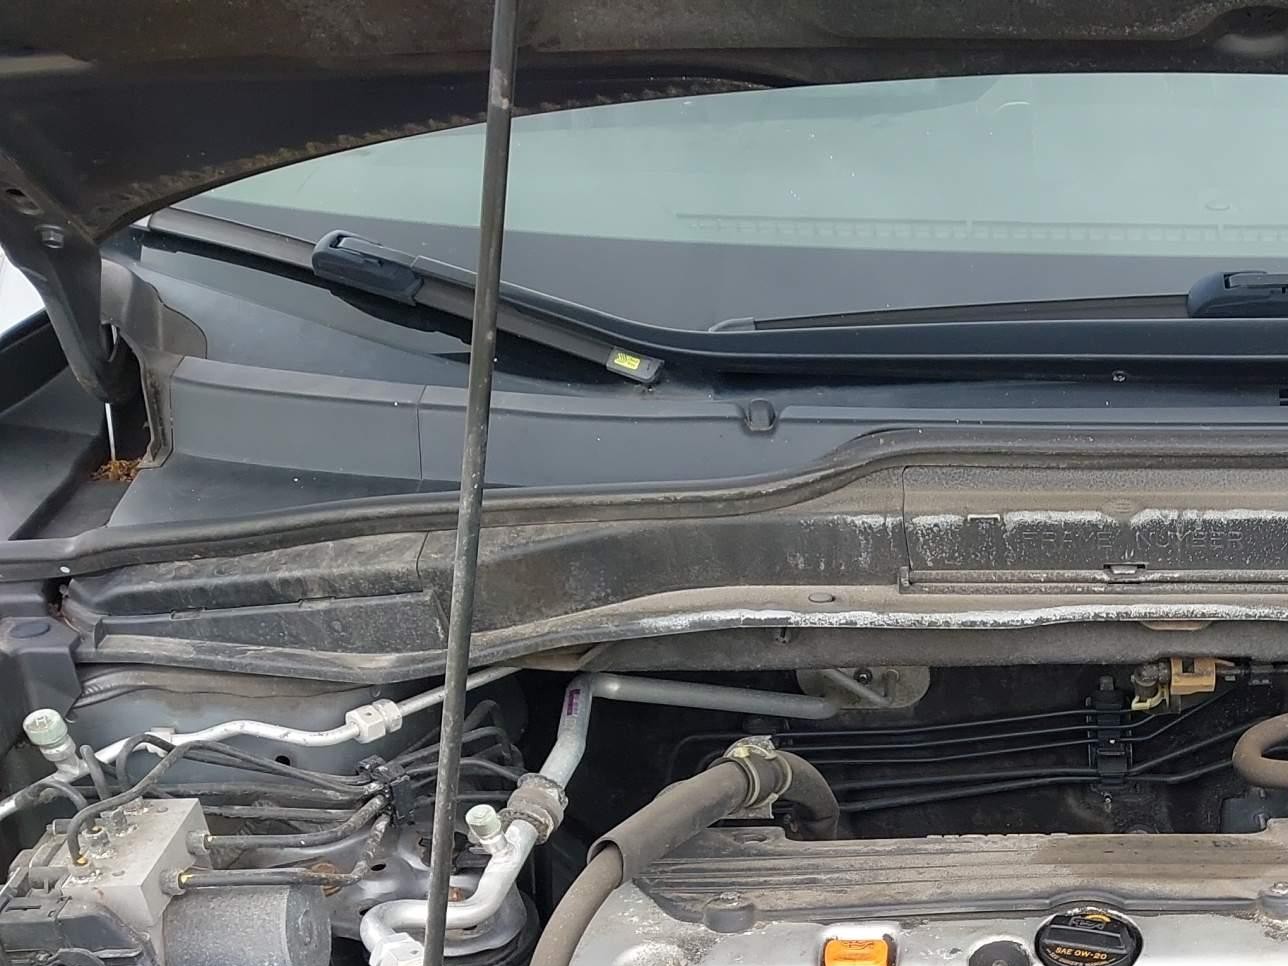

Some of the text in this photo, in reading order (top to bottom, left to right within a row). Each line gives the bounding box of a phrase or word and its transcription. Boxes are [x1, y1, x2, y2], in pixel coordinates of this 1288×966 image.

[1022, 530, 1244, 550] FRAME NUMBER
[1055, 947, 1107, 960] SAE 0W-20
